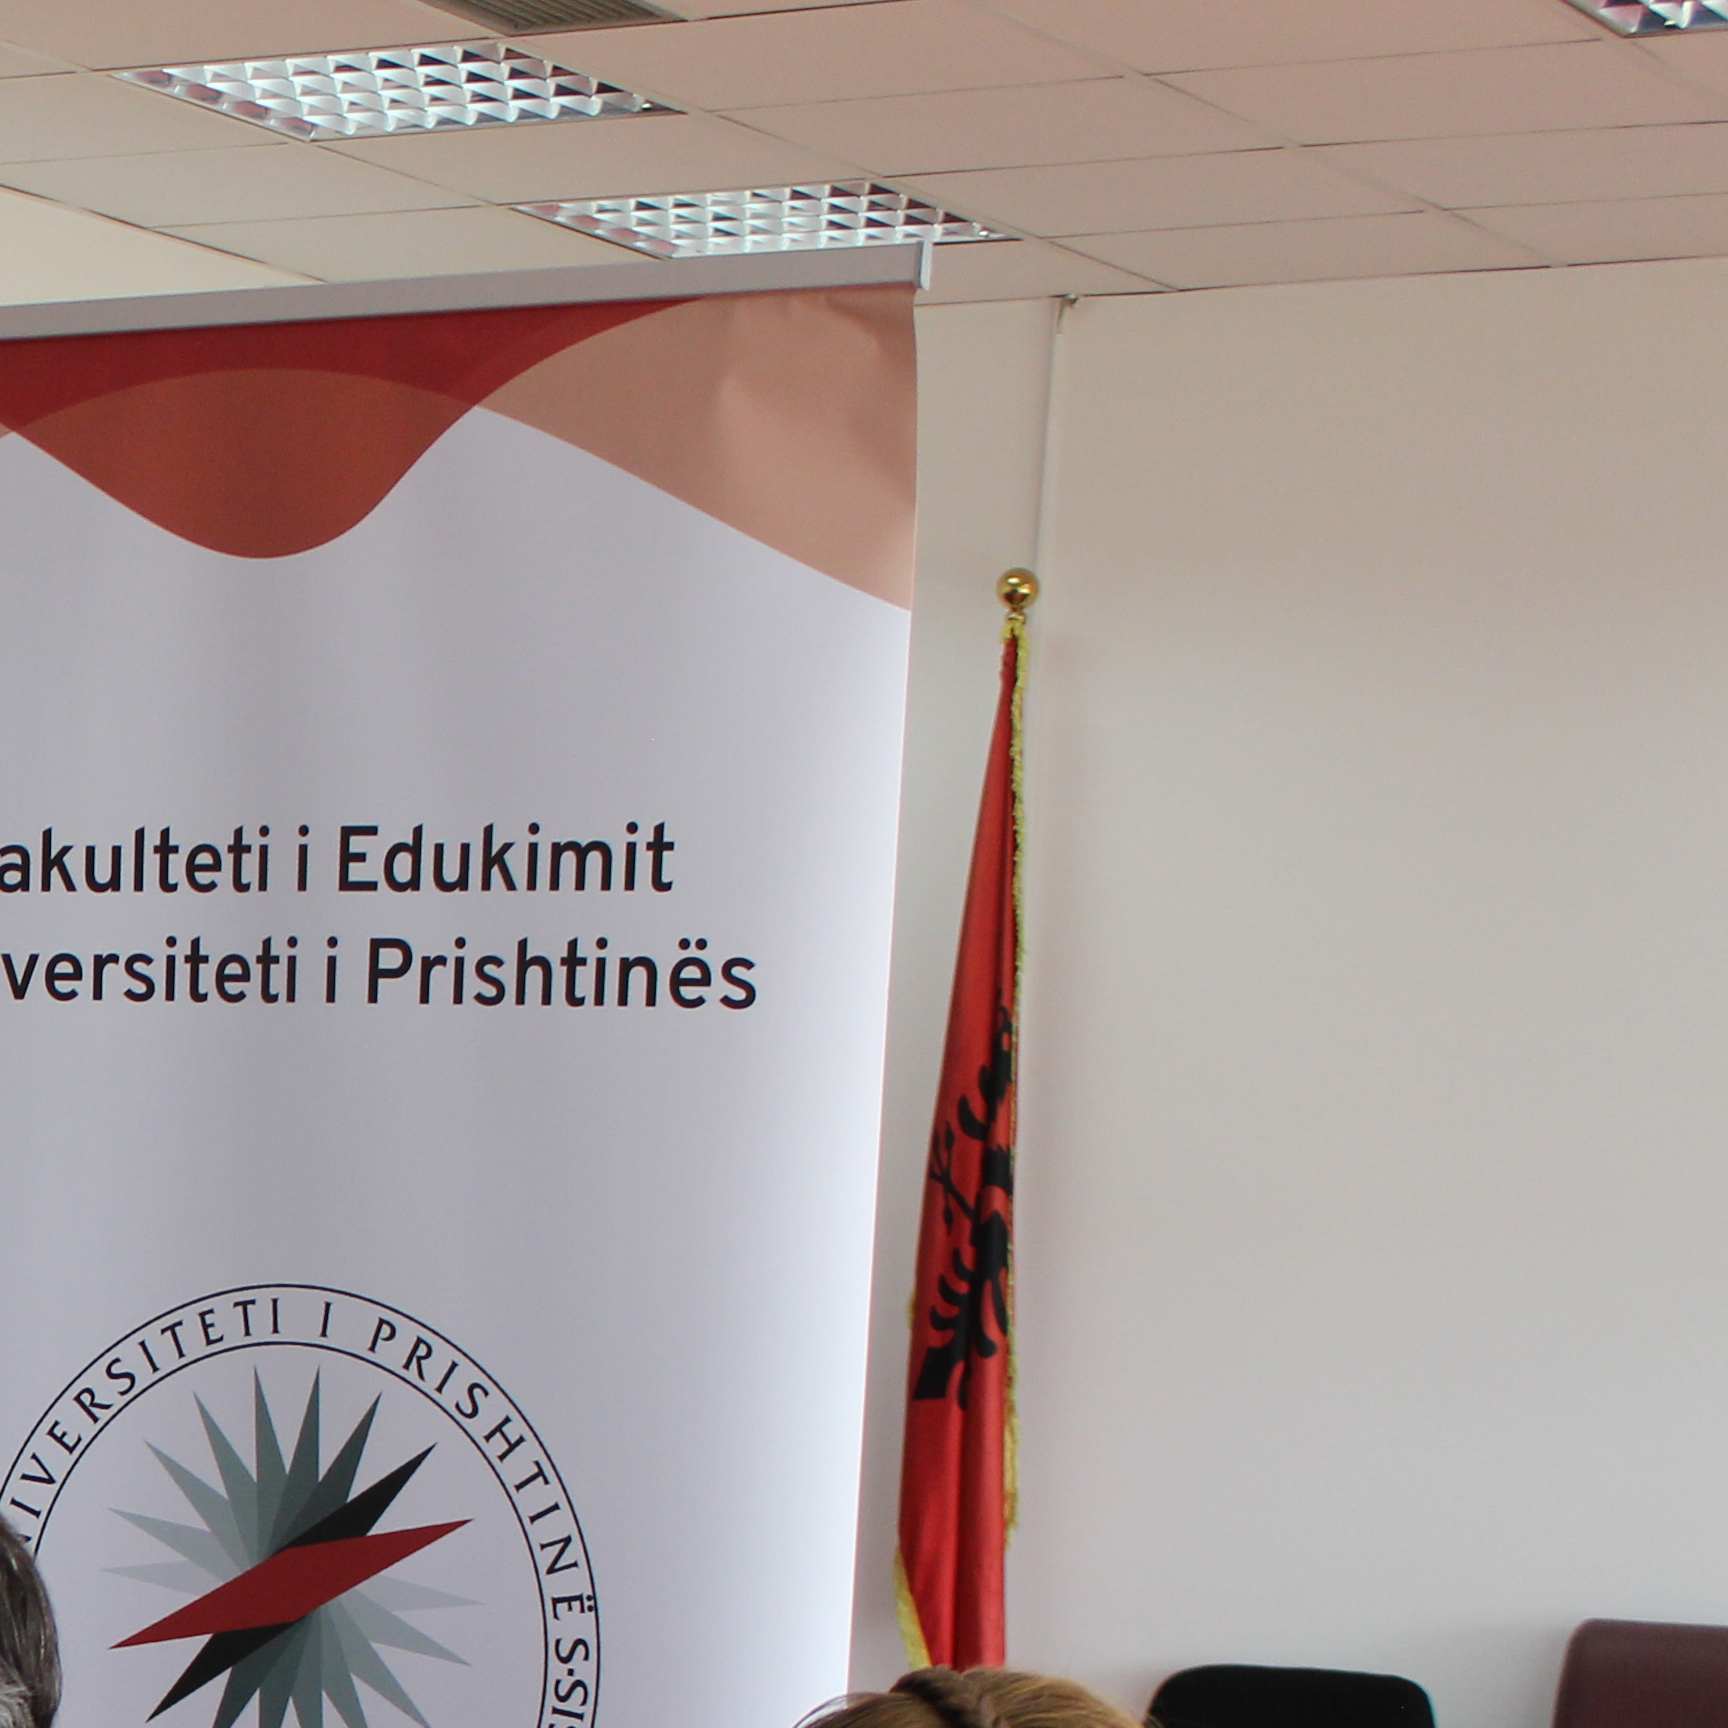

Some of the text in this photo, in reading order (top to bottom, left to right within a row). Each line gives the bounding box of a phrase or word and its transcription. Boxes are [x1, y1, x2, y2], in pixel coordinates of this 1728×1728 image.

[296, 824, 311, 894] i
[336, 819, 677, 894] Edukimit
[324, 934, 340, 1006] i
[366, 935, 760, 1011] Prishtinës
[8, 1297, 598, 1669] IVERSITETI I PRISHTINËS
